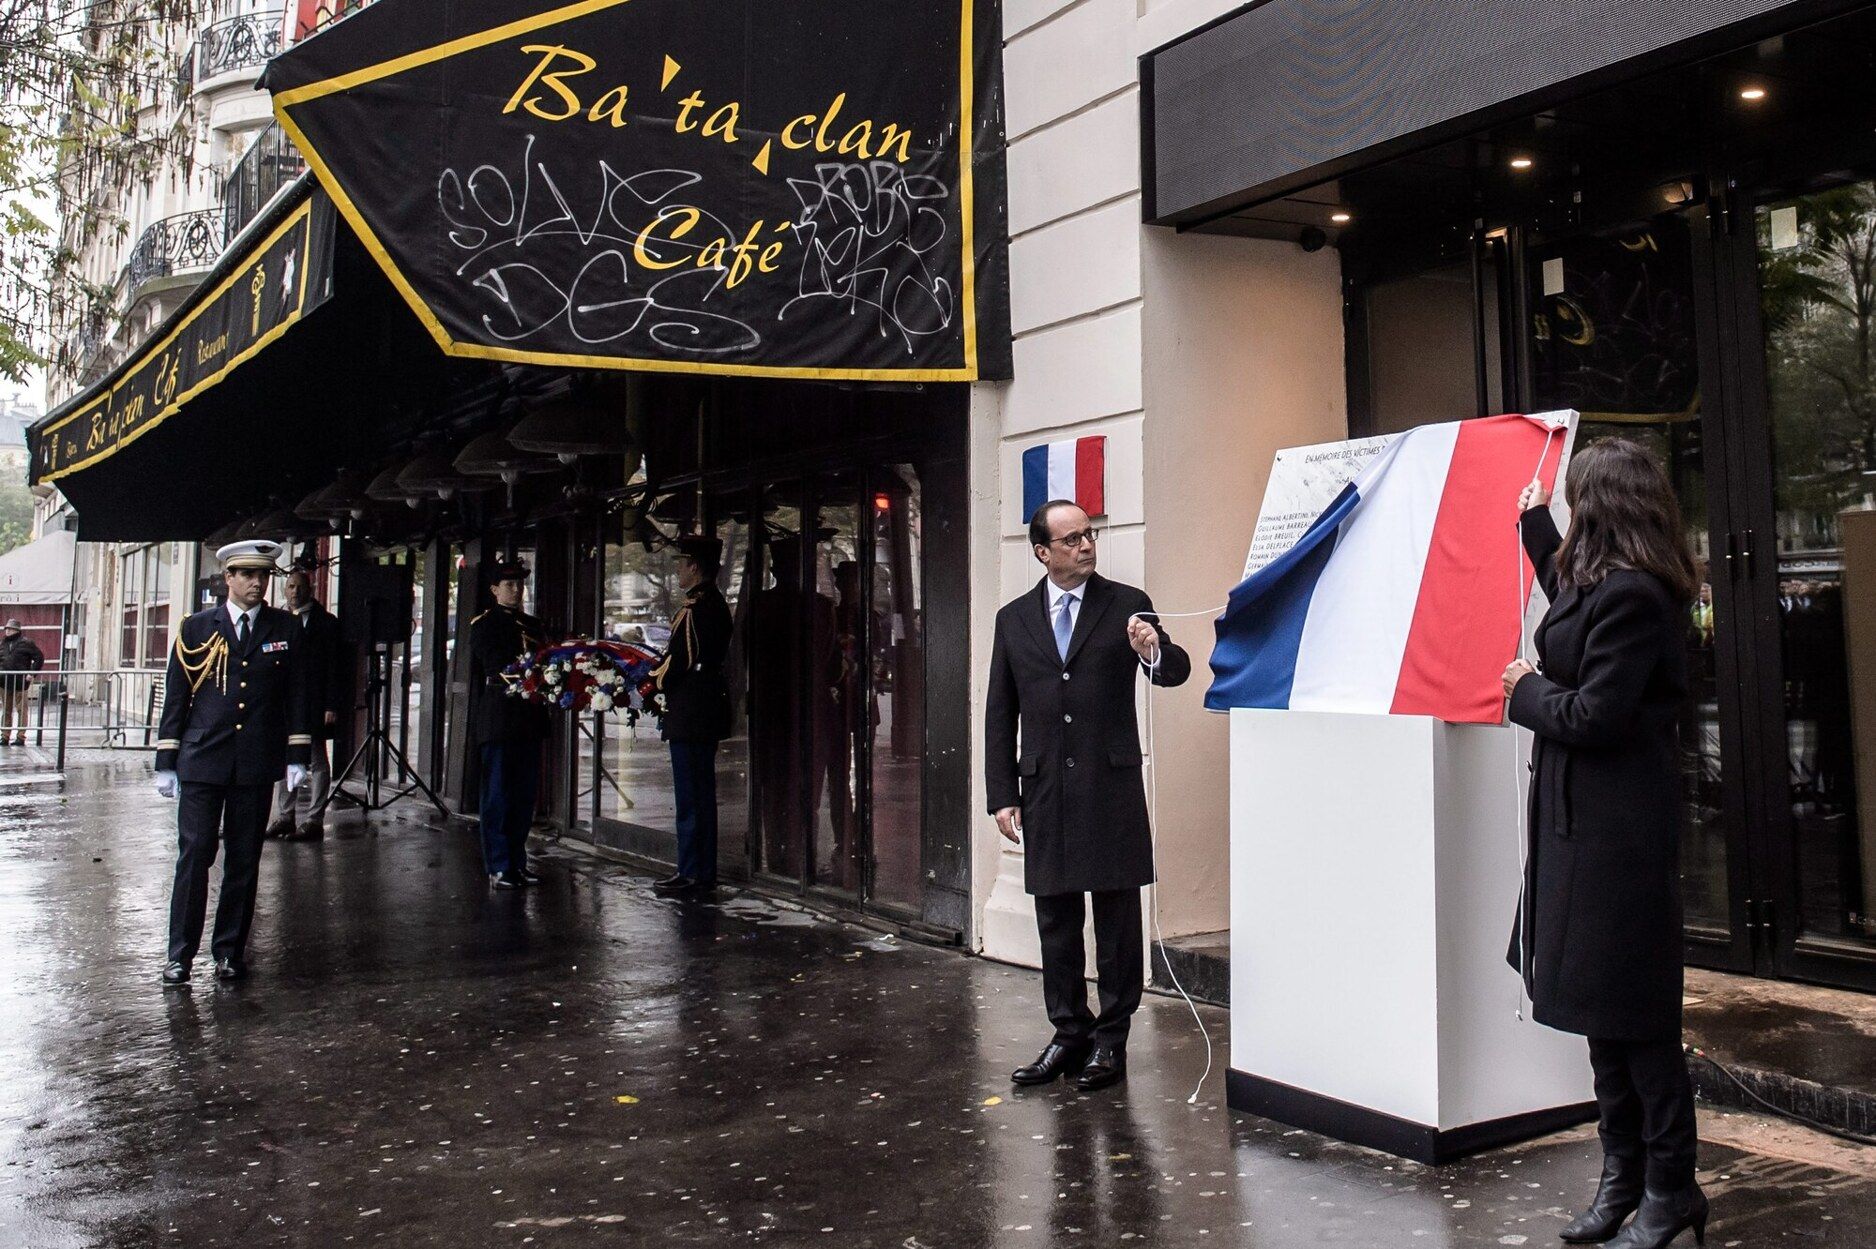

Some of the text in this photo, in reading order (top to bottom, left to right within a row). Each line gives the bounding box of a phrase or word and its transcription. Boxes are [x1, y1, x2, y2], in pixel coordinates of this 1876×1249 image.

[633, 207, 791, 289] Café
[1341, 449, 1353, 459] DES
[1353, 446, 1381, 458] VICTIMES
